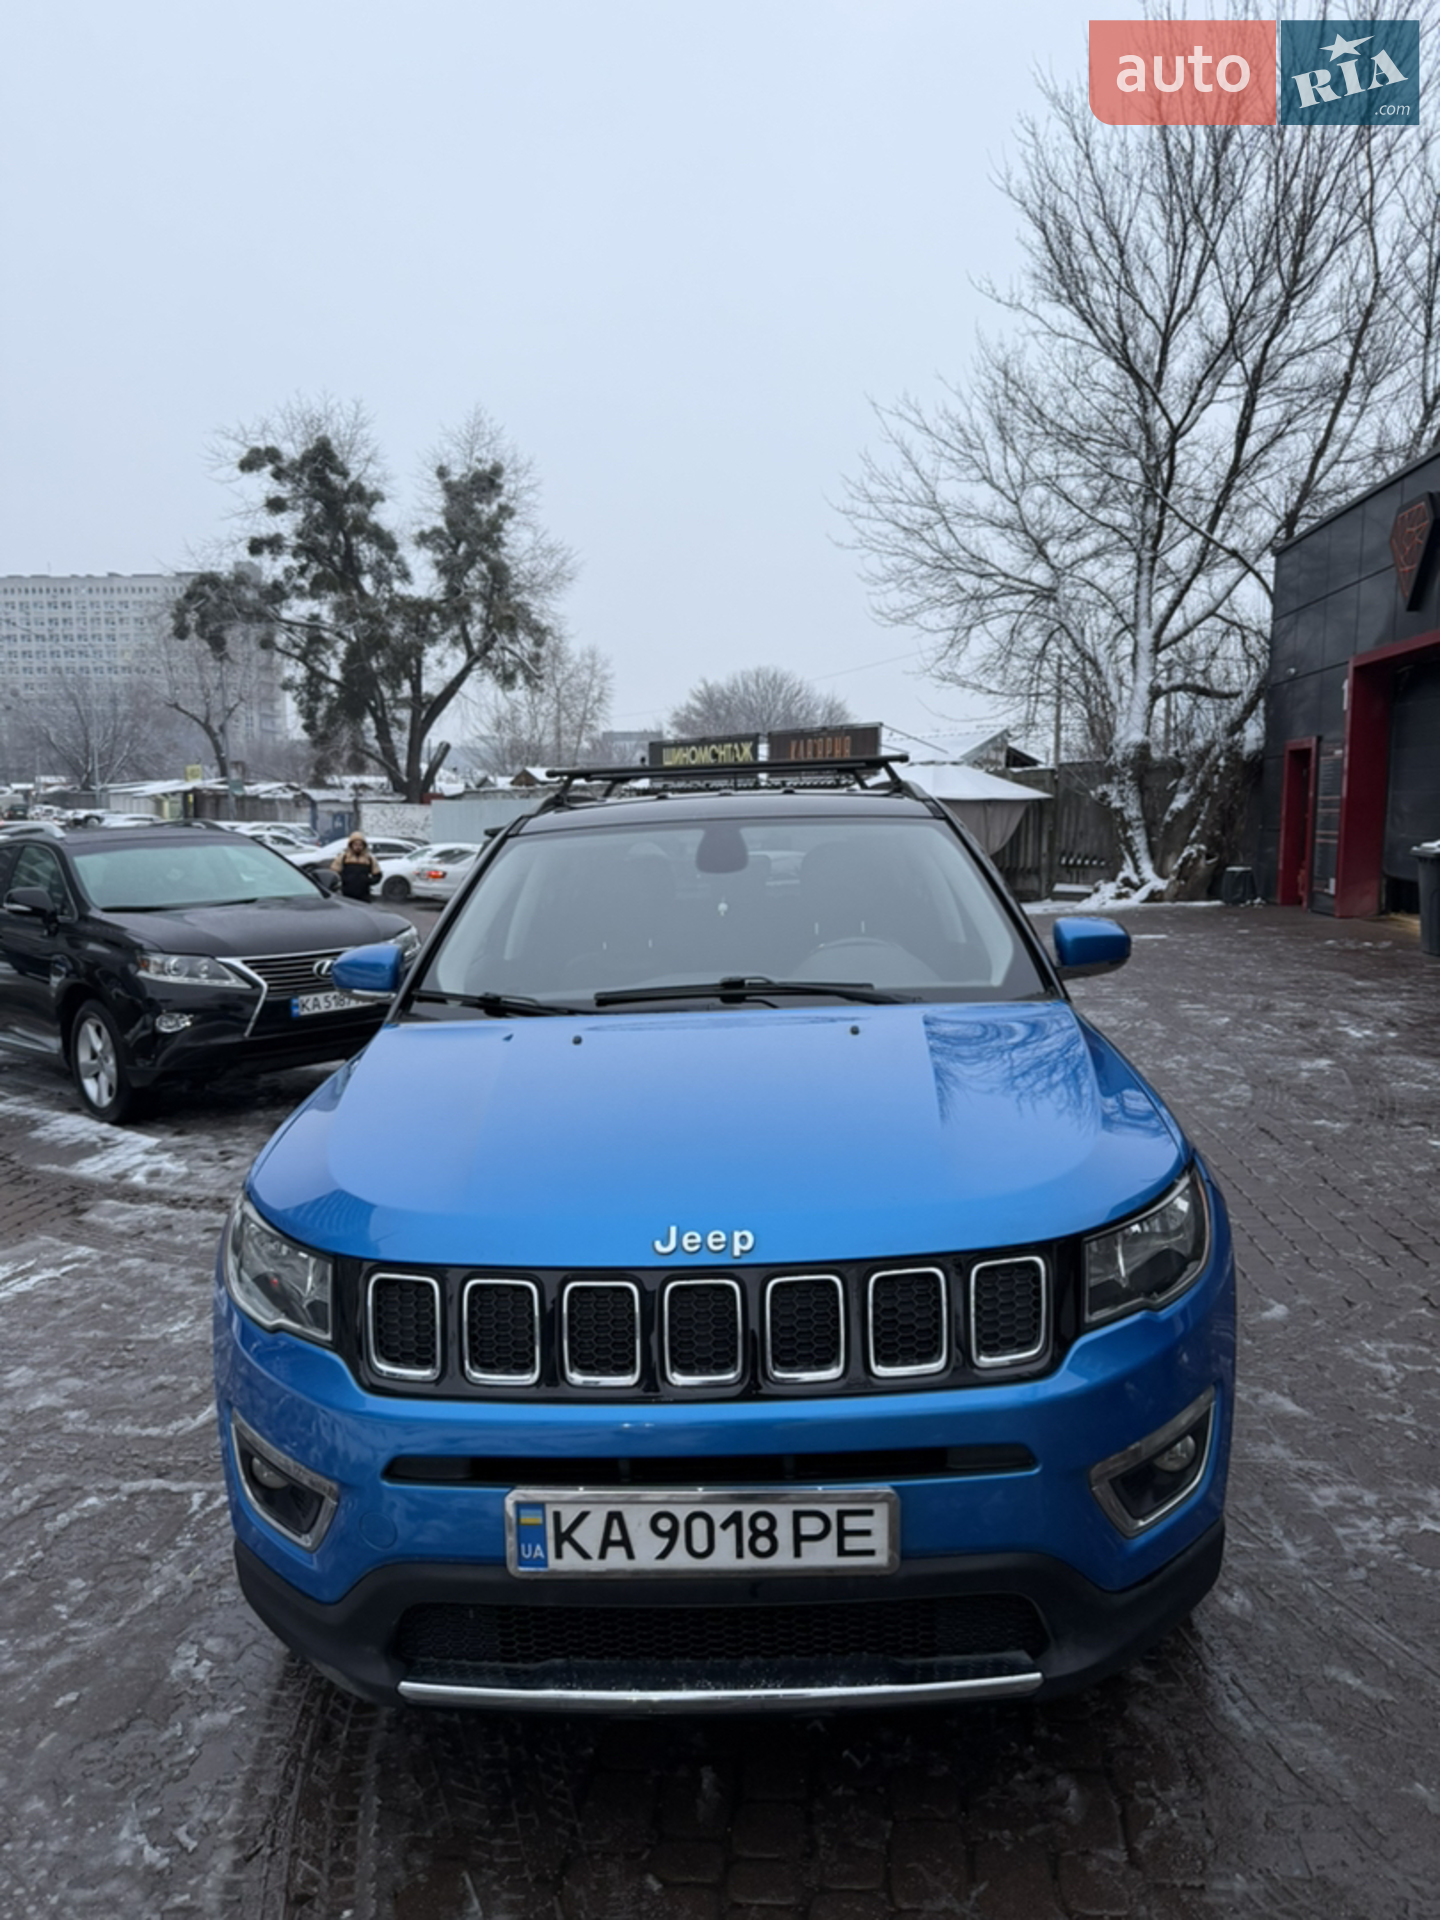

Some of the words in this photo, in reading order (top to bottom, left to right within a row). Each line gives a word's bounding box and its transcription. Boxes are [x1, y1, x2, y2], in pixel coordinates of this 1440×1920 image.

[300, 996, 322, 1013] KA
[653, 1225, 755, 1258] Jeep
[552, 1510, 636, 1561] KA
[649, 1509, 779, 1561] 9018
[792, 1508, 876, 1559] PE
[520, 1543, 545, 1559] UA
